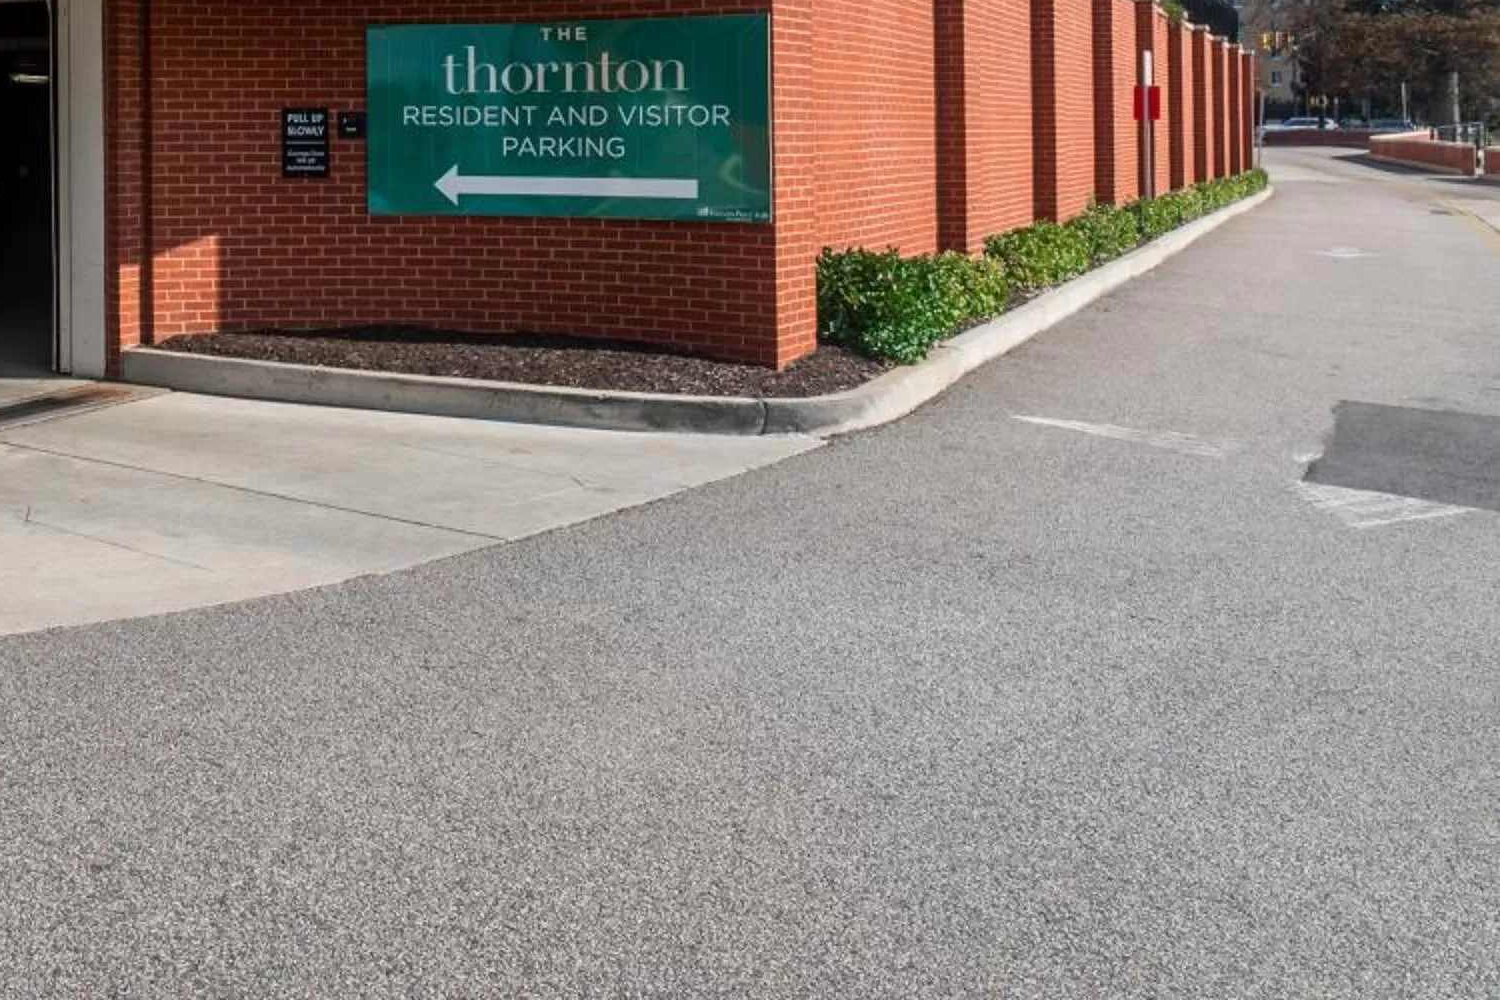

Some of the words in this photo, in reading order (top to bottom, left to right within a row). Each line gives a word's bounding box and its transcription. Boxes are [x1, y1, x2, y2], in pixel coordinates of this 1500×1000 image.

[539, 27, 588, 41] THE
[440, 45, 691, 94] thornton
[287, 113, 309, 123] PULL
[311, 113, 325, 123] UP
[403, 105, 538, 127] RESIDENT
[547, 105, 609, 127] AND
[617, 104, 731, 126] VISITOR
[502, 136, 626, 159] PARKING
